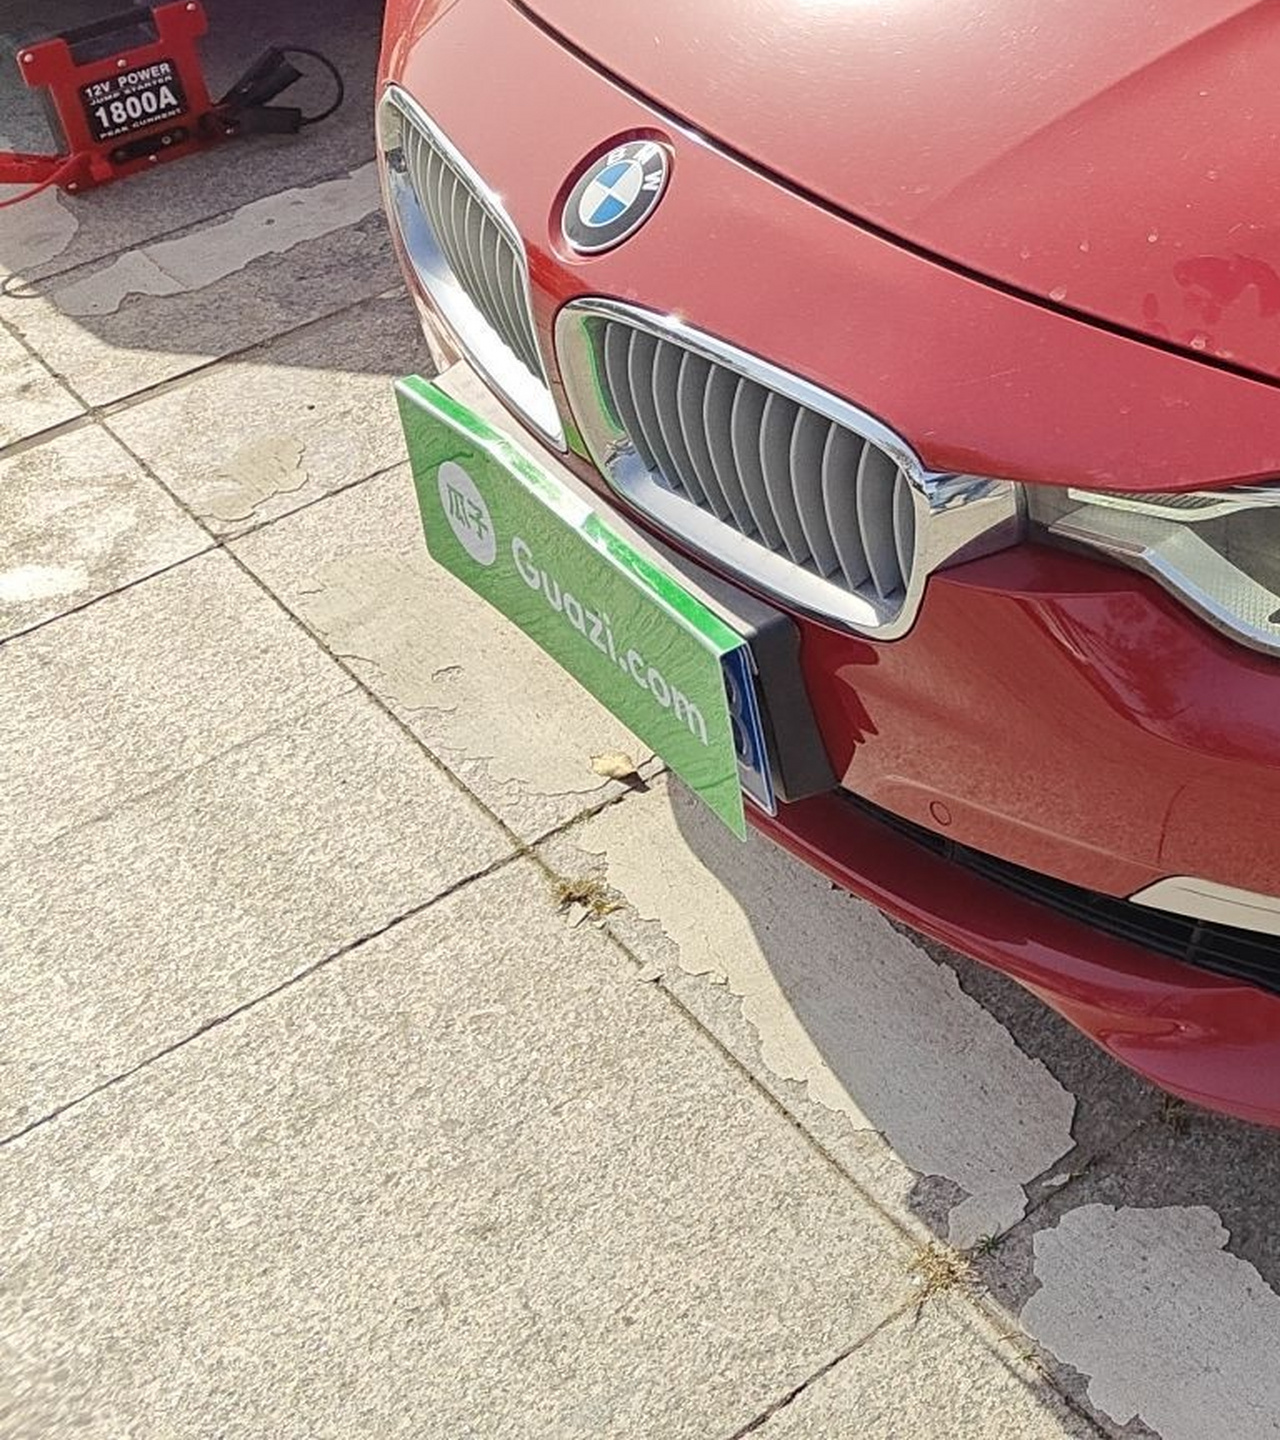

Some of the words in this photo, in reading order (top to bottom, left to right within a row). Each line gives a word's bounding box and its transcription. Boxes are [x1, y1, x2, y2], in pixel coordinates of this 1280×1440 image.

[85, 80, 110, 98] 12V
[117, 62, 171, 88] POWER
[95, 85, 179, 128] 1800A
[132, 107, 182, 128] CURRENT
[606, 142, 664, 191] BMW
[446, 482, 489, 541] 瓜子
[511, 536, 709, 747] Guazi.com
